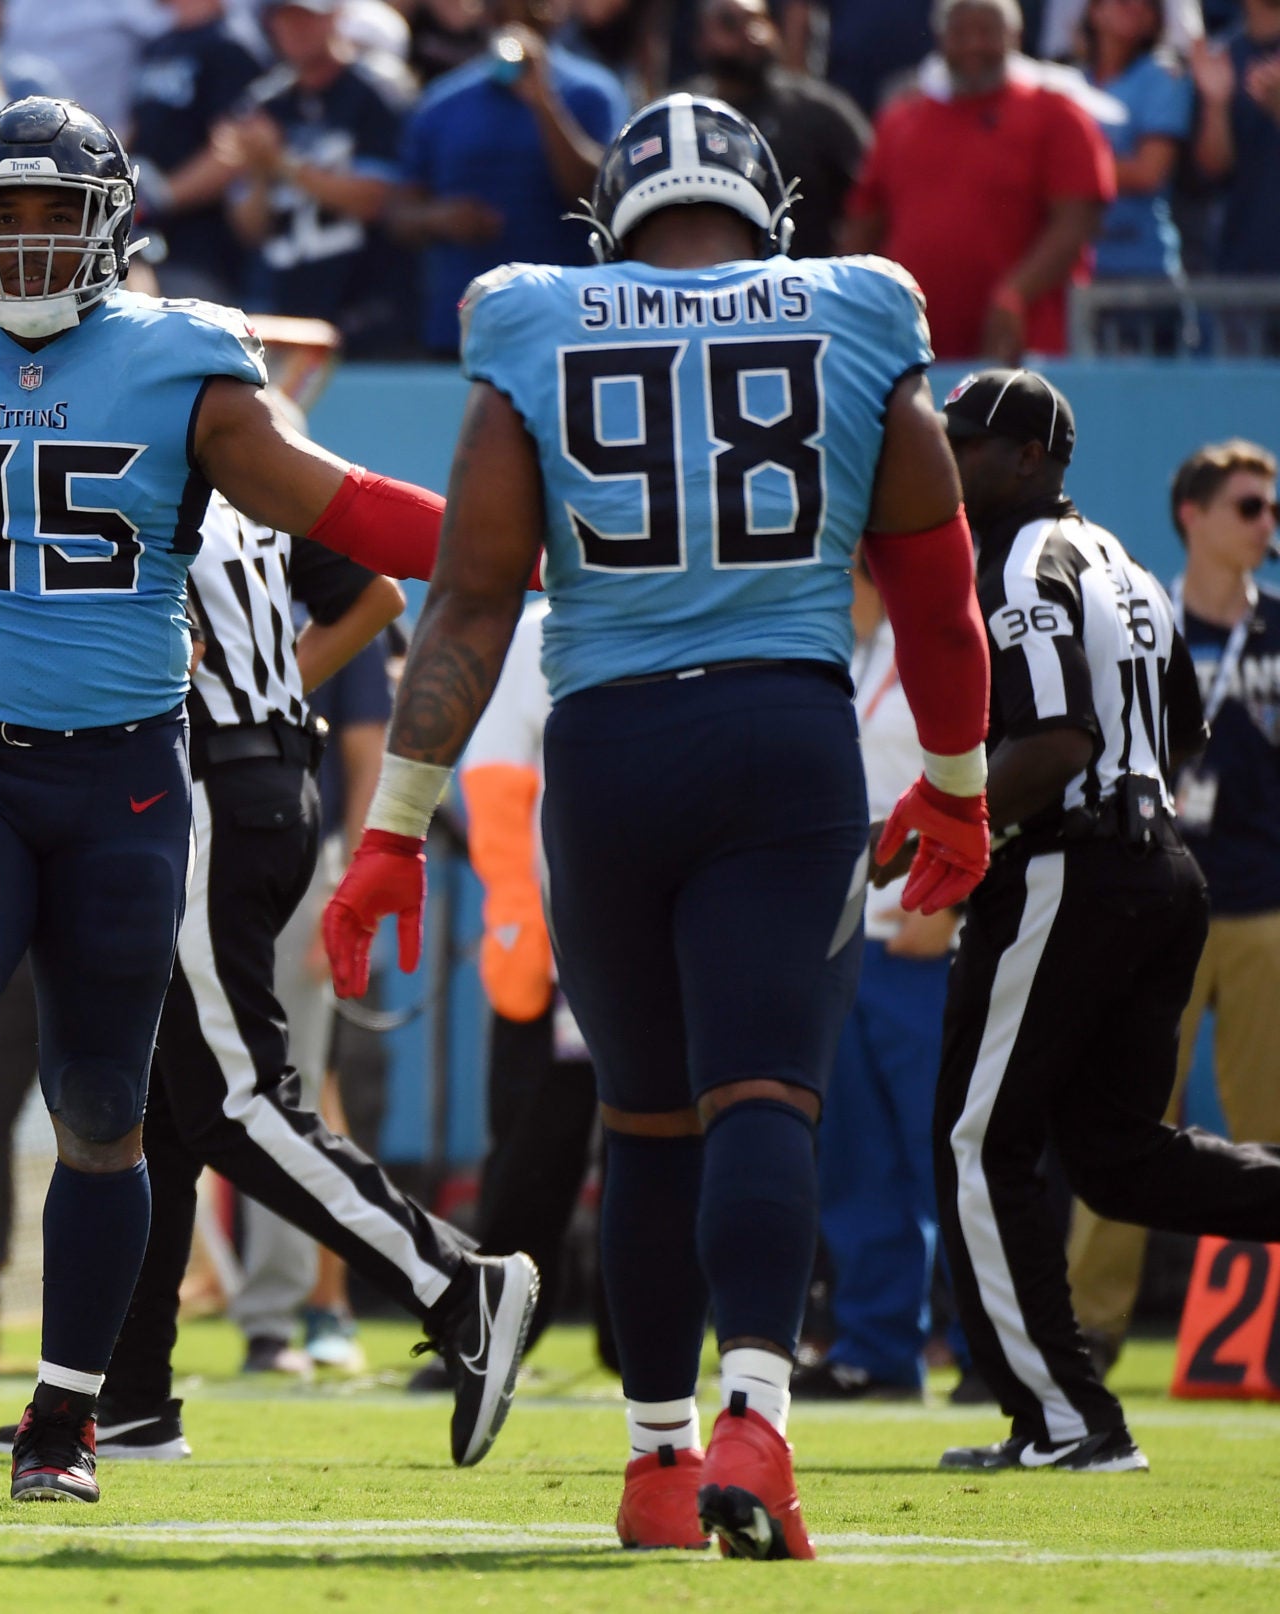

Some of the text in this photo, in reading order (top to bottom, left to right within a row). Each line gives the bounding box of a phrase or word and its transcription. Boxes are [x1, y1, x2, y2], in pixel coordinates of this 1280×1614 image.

[10, 161, 40, 171] TITANS
[639, 176, 739, 198] TENNESSEE
[578, 275, 813, 331] SIMMONS
[22, 375, 39, 386] NFL
[557, 334, 831, 574] 98
[1001, 605, 1058, 641] 36
[1185, 1240, 1280, 1385] 2
